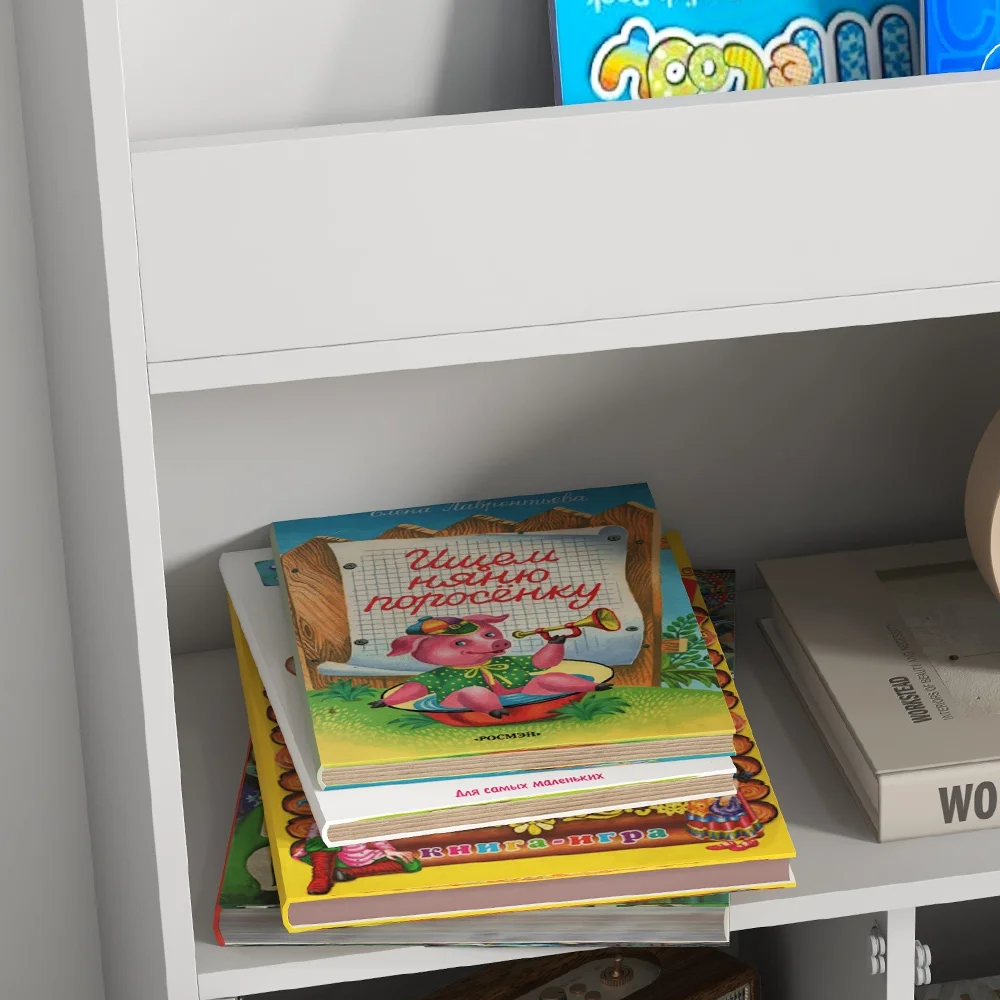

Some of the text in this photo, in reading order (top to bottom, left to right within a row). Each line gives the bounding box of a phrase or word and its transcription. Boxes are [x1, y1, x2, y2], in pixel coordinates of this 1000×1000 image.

[405, 548, 560, 573] Ищем
[408, 568, 550, 590] няню
[363, 583, 602, 615] поросёнку
[888, 675, 933, 724] WORKSTEAD
[455, 772, 605, 798] Для самых маленьких
[419, 827, 669, 859] книга-игра
